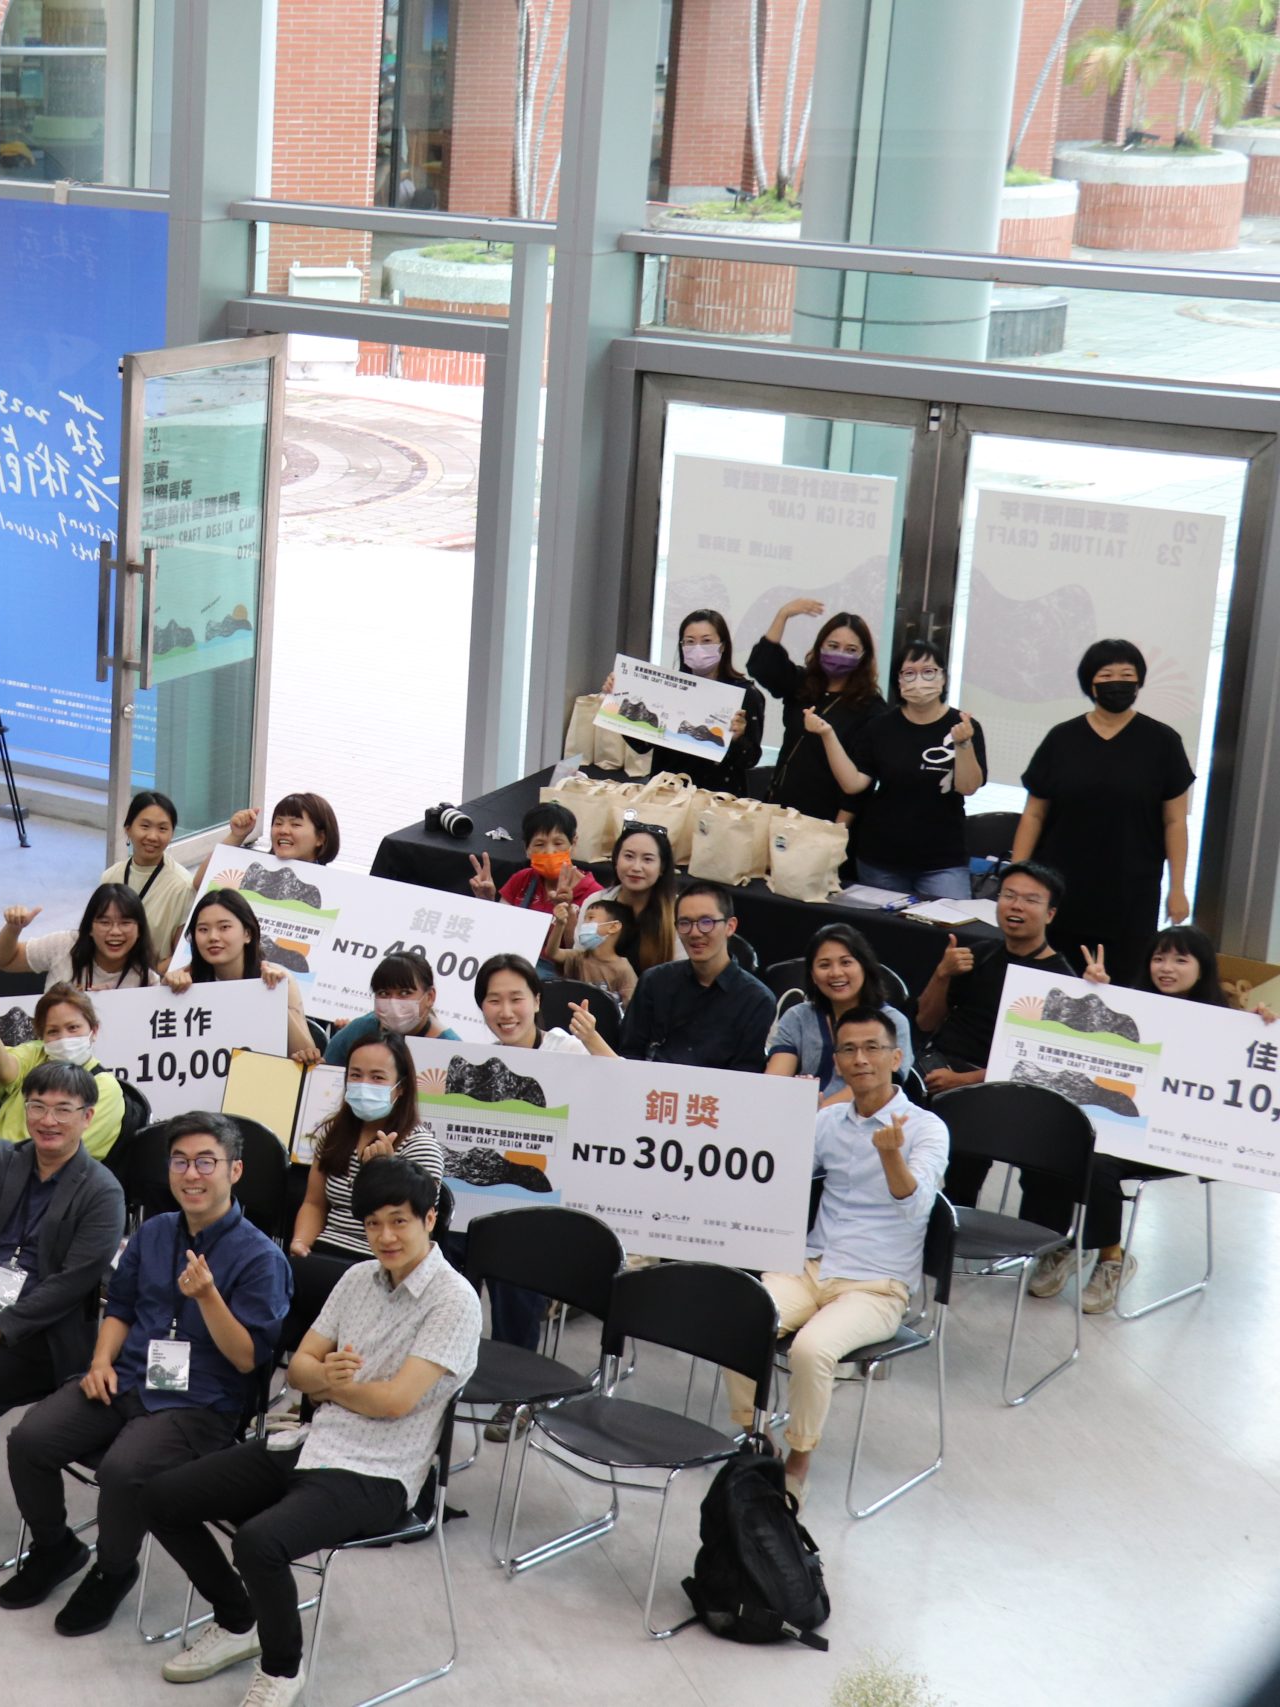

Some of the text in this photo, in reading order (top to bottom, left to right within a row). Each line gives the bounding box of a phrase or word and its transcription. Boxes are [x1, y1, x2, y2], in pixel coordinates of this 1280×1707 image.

[143, 460, 169, 485] 臺東
[178, 526, 201, 544] CRAFT
[206, 519, 233, 539] DESIGN
[239, 514, 256, 531] CAMP
[409, 907, 476, 943] 銀獎
[332, 938, 378, 959] NTD
[150, 1007, 212, 1039] 佳作
[136, 1046, 252, 1087] 10,00
[1162, 1077, 1216, 1101] NTD
[645, 1089, 721, 1129] 銅獎
[446, 1133, 542, 1151] TAITUNG CRAFT DESIGN CAMP
[572, 1135, 776, 1183] NTD 30,000
